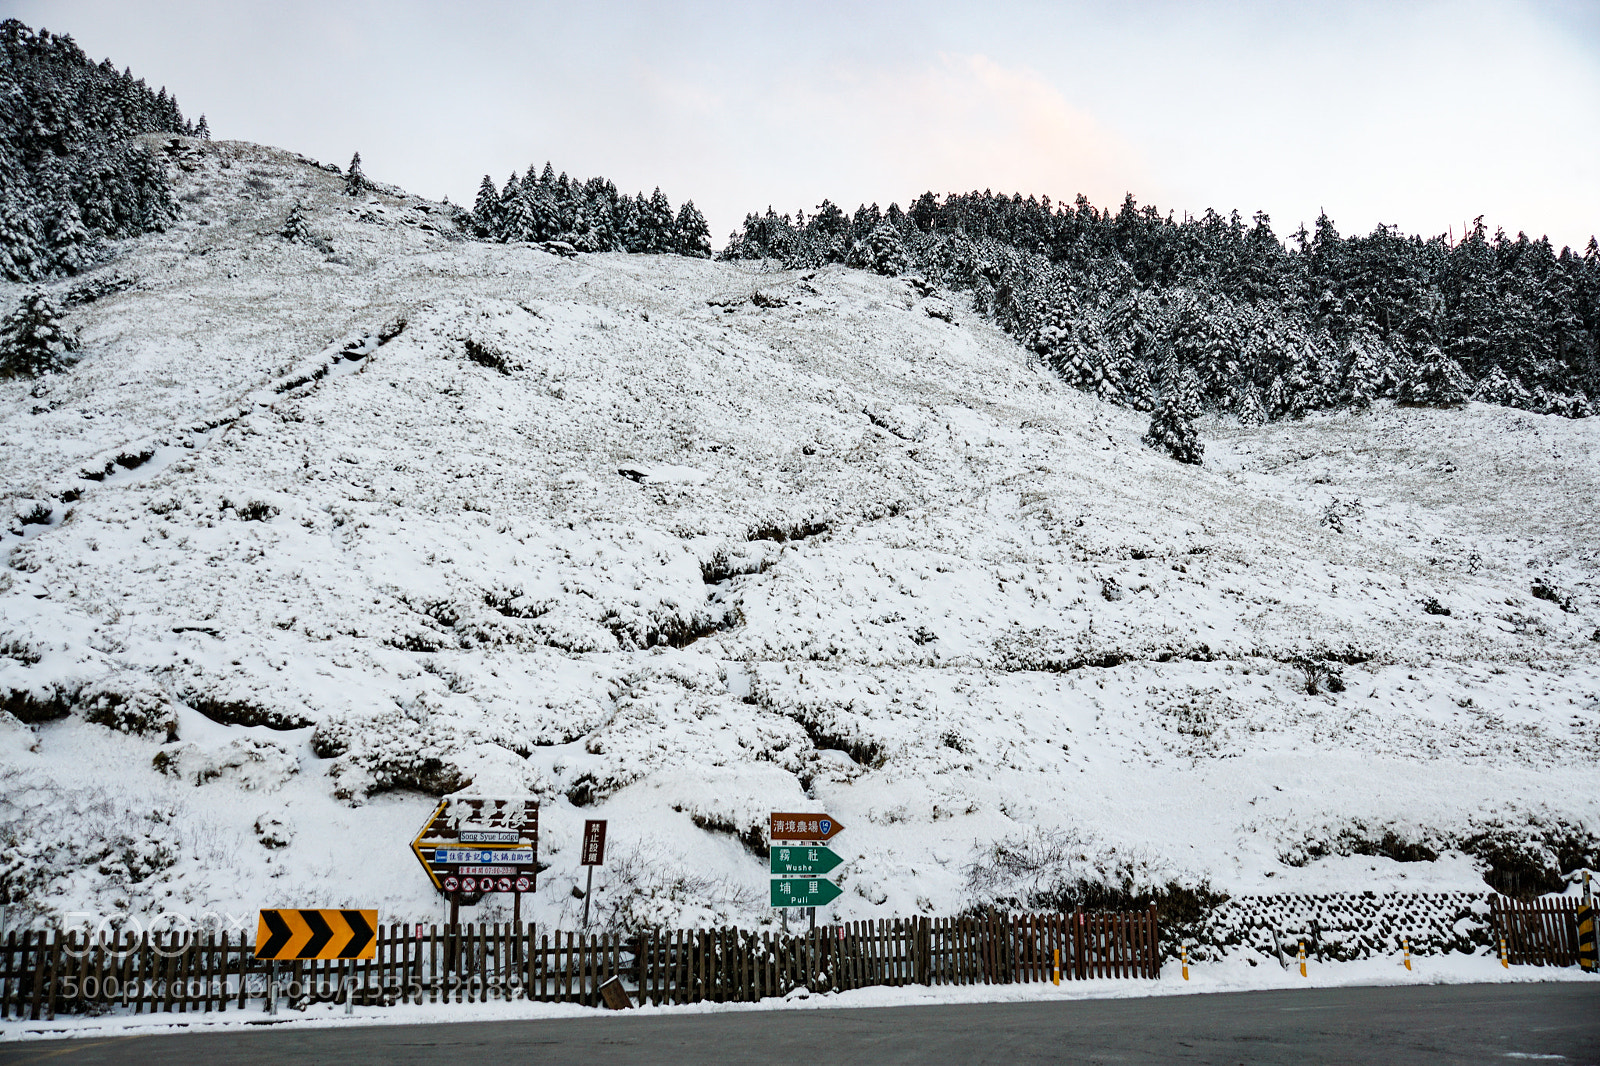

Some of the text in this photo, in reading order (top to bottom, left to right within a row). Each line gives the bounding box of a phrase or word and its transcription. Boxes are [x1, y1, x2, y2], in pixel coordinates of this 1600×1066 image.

[774, 820, 819, 833] 清境農場
[461, 831, 518, 842] Song Syue Lodge
[588, 823, 600, 862] 禁止設攤
[449, 852, 480, 861] 住宿登記
[791, 896, 808, 904] Puli
